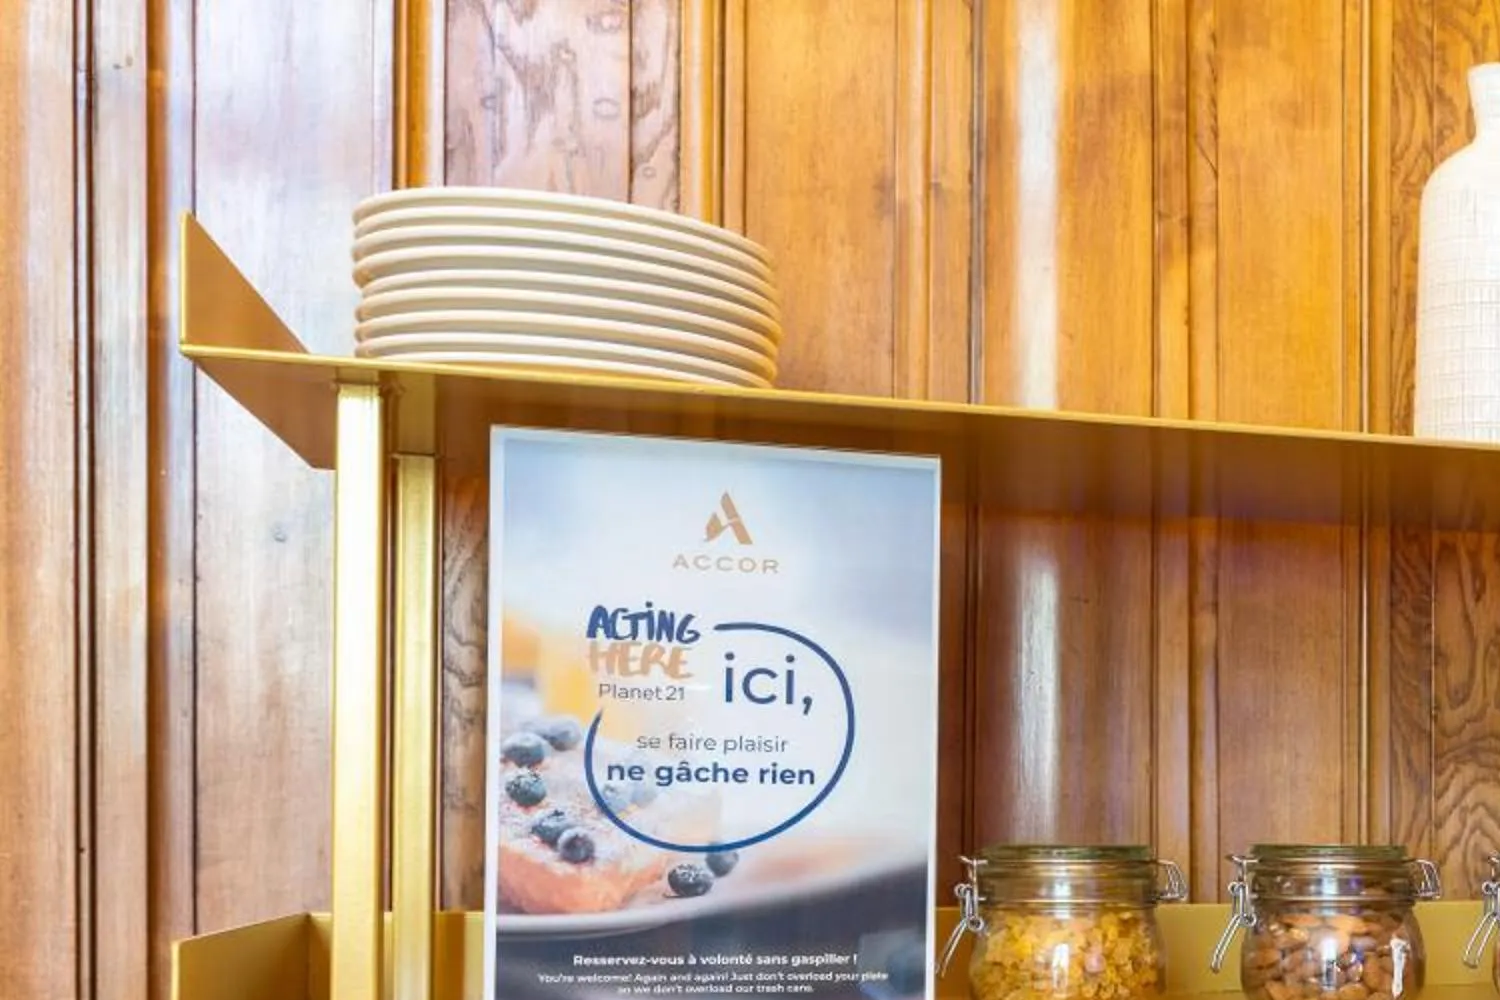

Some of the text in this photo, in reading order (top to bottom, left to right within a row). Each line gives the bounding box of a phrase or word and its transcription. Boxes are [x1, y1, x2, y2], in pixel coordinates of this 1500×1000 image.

[672, 554, 779, 574] ACCOR
[590, 640, 693, 680] HERE
[598, 683, 662, 701] Planet
[724, 652, 813, 715] ici,
[636, 734, 788, 754] se faire plaisir
[607, 760, 815, 787] ne gâche rien
[688, 953, 697, 965] à
[700, 952, 752, 965] volonté
[756, 955, 788, 965] sans
[791, 953, 850, 967] gaspiller
[670, 974, 691, 982] and
[756, 972, 784, 981] don't
[834, 973, 859, 983] your
[654, 985, 682, 993] don't
[686, 984, 733, 993] overload
[756, 984, 784, 992] trash
